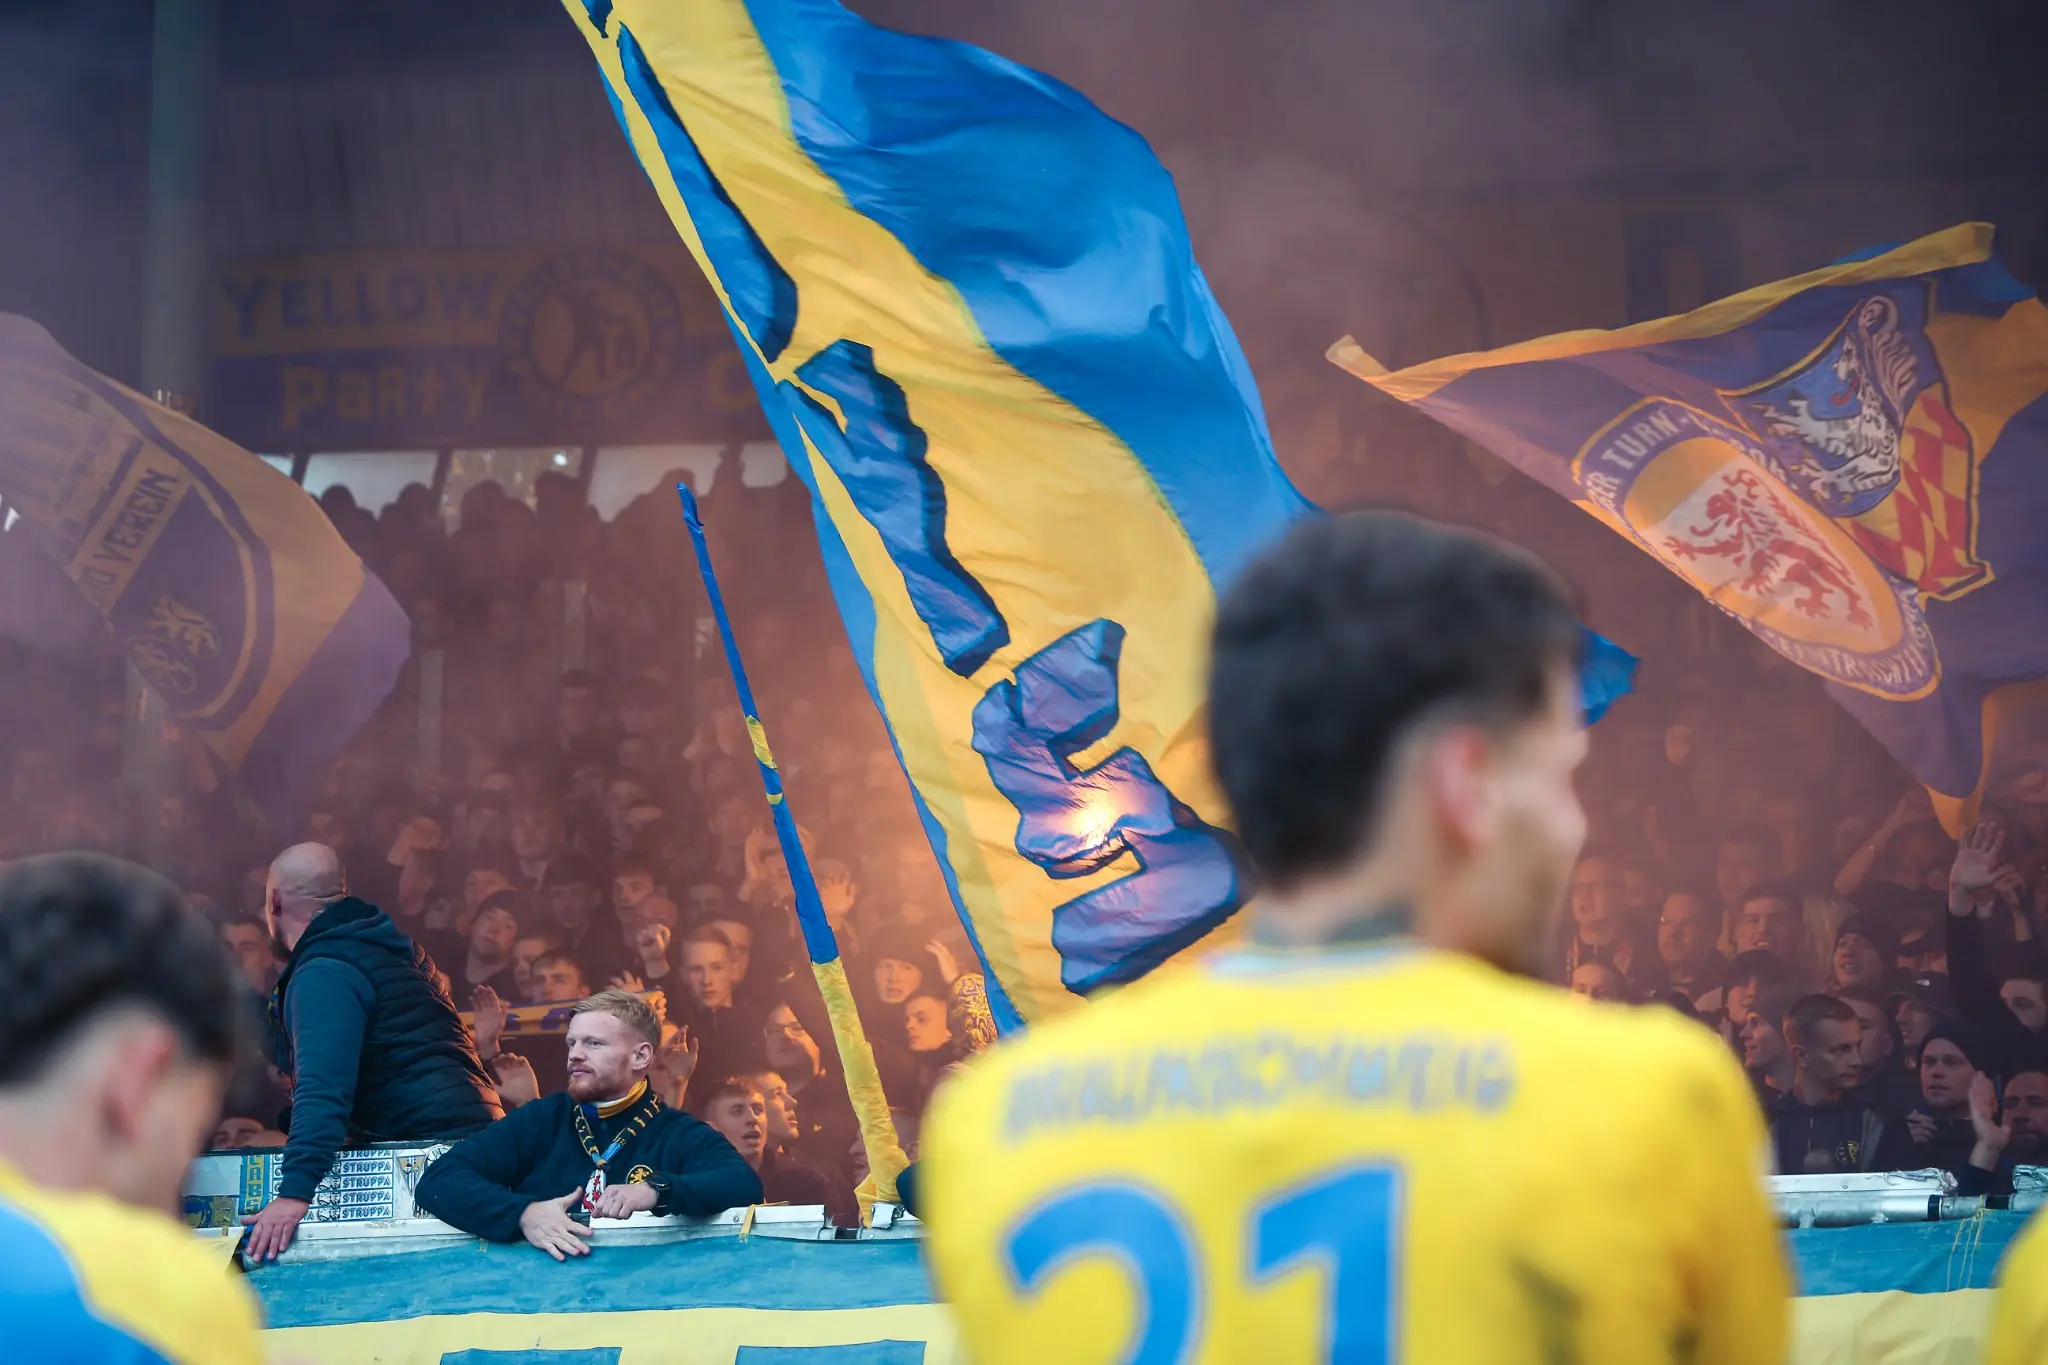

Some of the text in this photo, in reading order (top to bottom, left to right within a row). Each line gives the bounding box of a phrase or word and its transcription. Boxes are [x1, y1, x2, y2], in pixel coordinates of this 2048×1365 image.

[219, 270, 496, 342] YELLOW
[92, 467, 180, 562] VEREIN
[342, 1161, 391, 1173] STRUPPA
[342, 1176, 391, 1188] STRUPPA
[342, 1191, 391, 1203] STRUPPA
[341, 1206, 391, 1218] STRUPPA
[1001, 1160, 1403, 1365] 21
